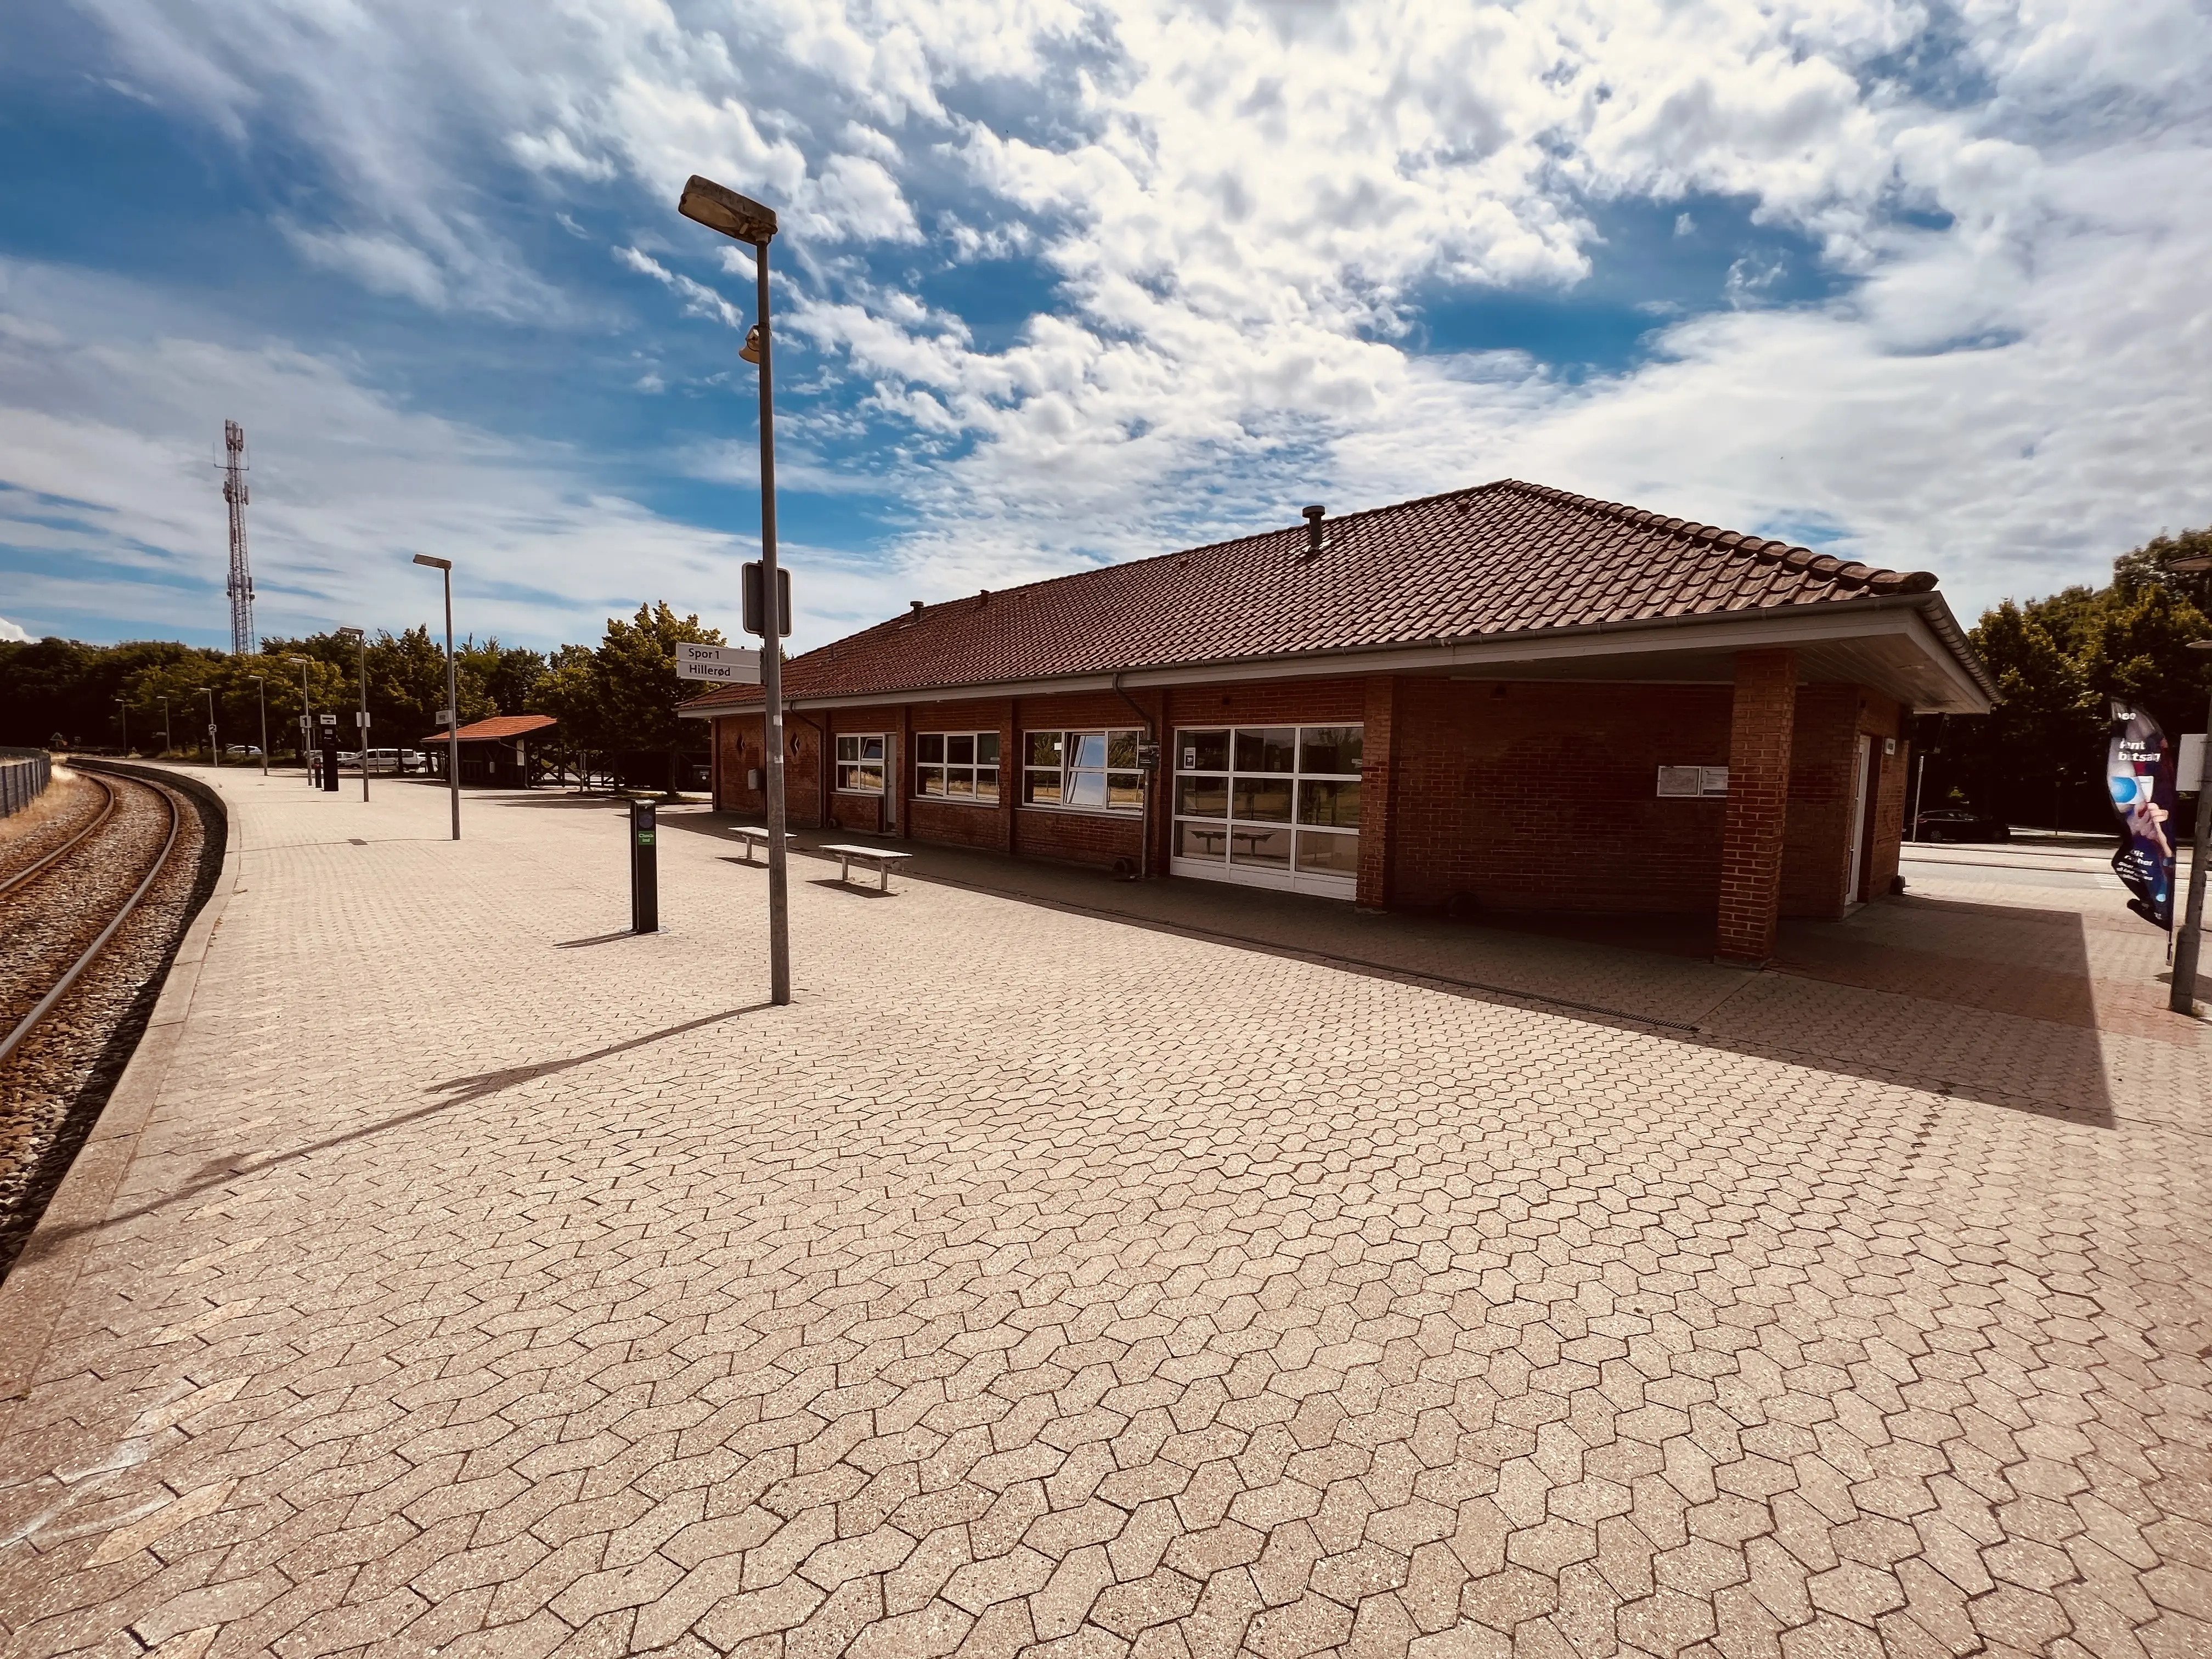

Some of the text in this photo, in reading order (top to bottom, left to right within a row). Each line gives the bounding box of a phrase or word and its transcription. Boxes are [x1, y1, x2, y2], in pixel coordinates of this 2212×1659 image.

[689, 648, 719, 660] Spor 1
[689, 664, 731, 676] Hillerød
[302, 717, 307, 726] 1
